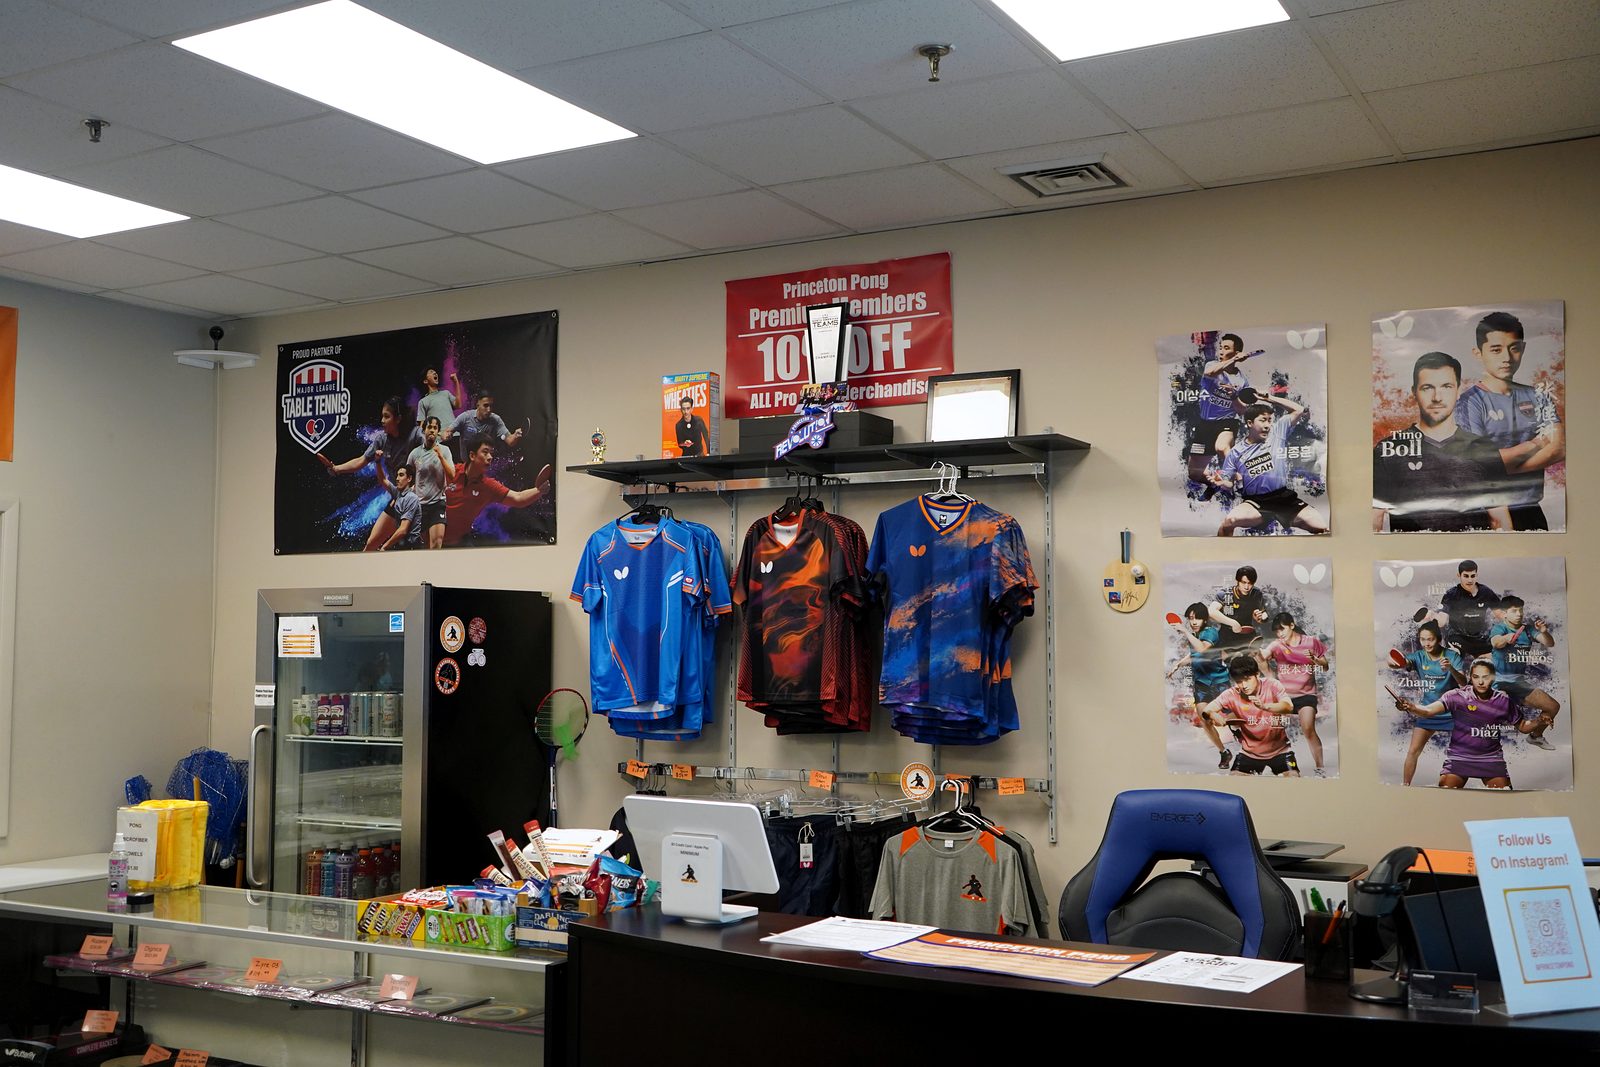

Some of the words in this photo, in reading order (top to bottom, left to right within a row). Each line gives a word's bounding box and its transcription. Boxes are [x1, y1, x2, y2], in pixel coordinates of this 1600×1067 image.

[783, 277, 847, 299] Princeton
[850, 273, 889, 291] Pong
[832, 291, 927, 318] embers
[812, 320, 839, 328] TEAMS
[292, 349, 310, 359] PROUD
[310, 346, 334, 358] PARTNER
[335, 345, 342, 354] OF
[848, 322, 912, 375] OFF
[296, 385, 314, 394] MAJOR
[315, 383, 336, 393] LEAGUE
[750, 392, 771, 409] ALL
[774, 391, 797, 408] Pro
[847, 379, 928, 401] erchandis
[285, 395, 313, 418] TABLE
[314, 392, 347, 416] TENNIS
[1390, 430, 1423, 440] Timo
[1380, 439, 1423, 458] Boll
[1245, 452, 1273, 469] Shinhan
[1508, 653, 1554, 665] Burgos
[1398, 677, 1436, 690] Zhang
[1470, 726, 1499, 738] Díaz
[1498, 833, 1534, 847] Follow
[1536, 833, 1552, 845] Us
[1491, 856, 1507, 869] On
[1509, 854, 1569, 870] Instagram!
[945, 936, 1061, 957] PRINCETON
[1062, 948, 1131, 962] PONG
[14, 1048, 37, 1061] Butterfly
